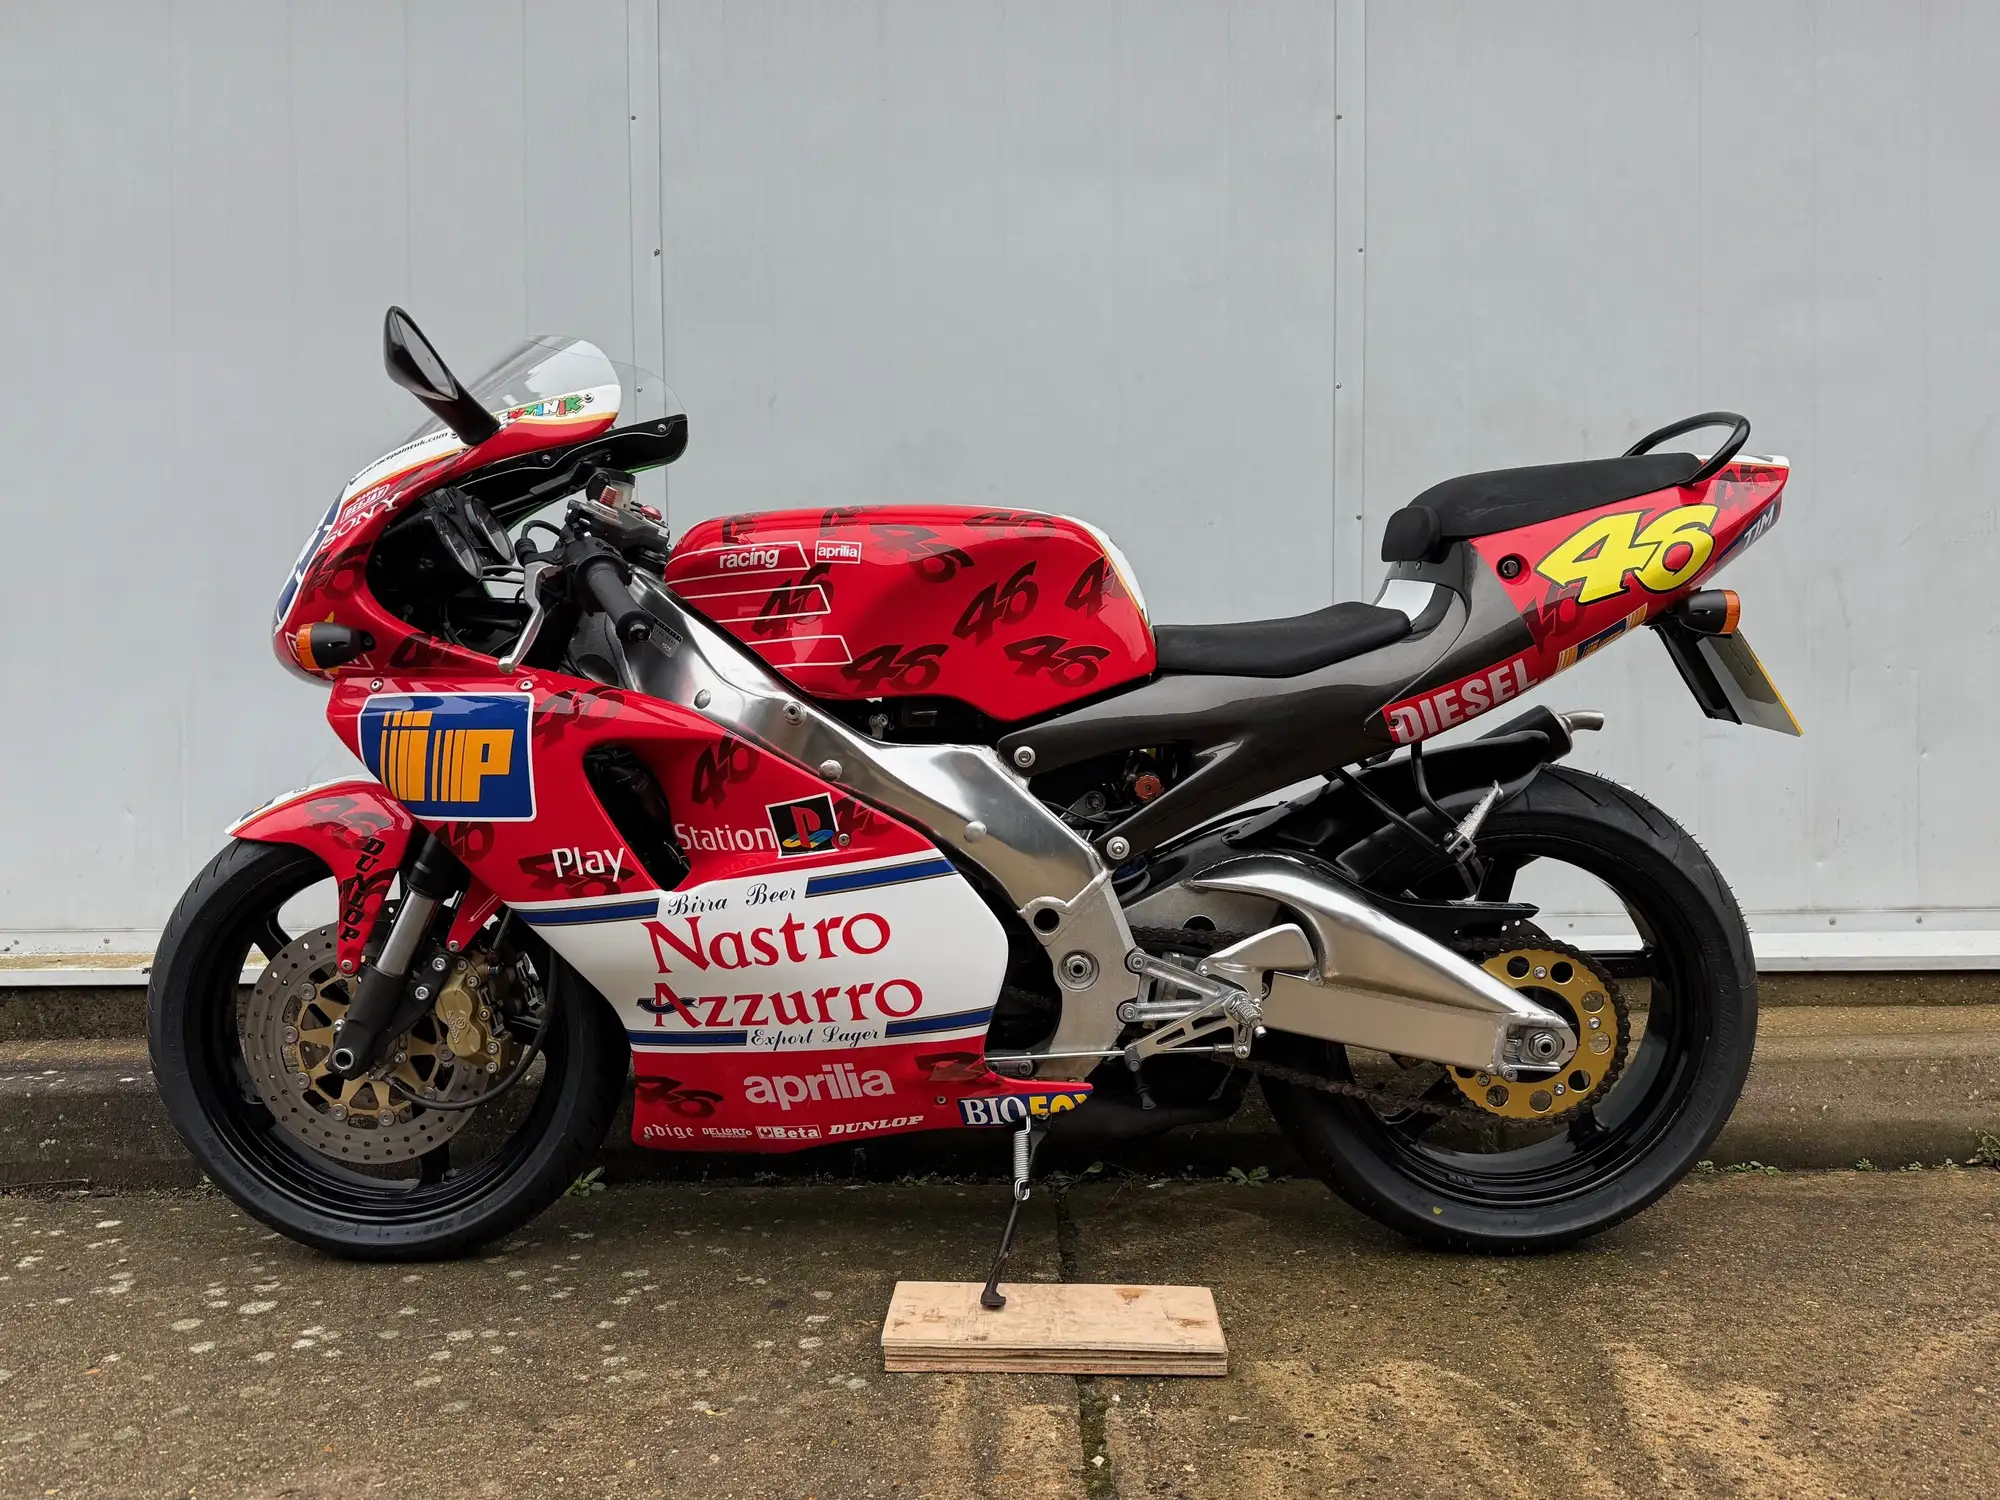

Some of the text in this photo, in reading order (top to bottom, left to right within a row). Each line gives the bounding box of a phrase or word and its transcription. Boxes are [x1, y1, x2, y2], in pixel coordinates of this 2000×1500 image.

[320, 491, 403, 551] SONY
[1743, 503, 1776, 549] TIM
[719, 547, 781, 569] racing
[817, 543, 858, 559] aprilia
[1536, 503, 1721, 605] 46
[952, 560, 1040, 646] 46
[840, 643, 949, 691] 46
[1003, 634, 1112, 688] 46
[1389, 658, 1538, 744] DIESEL
[551, 822, 776, 882] Play Station
[339, 836, 386, 942] DUNLOP
[667, 882, 797, 917] Birra Beer
[641, 912, 891, 974] Nastro
[653, 977, 923, 1028] Azzurro
[750, 1024, 879, 1052] Export Lager
[743, 1062, 896, 1111] aprilia
[773, 1126, 819, 1139] Beta
[828, 1114, 924, 1135] DUNLOP
